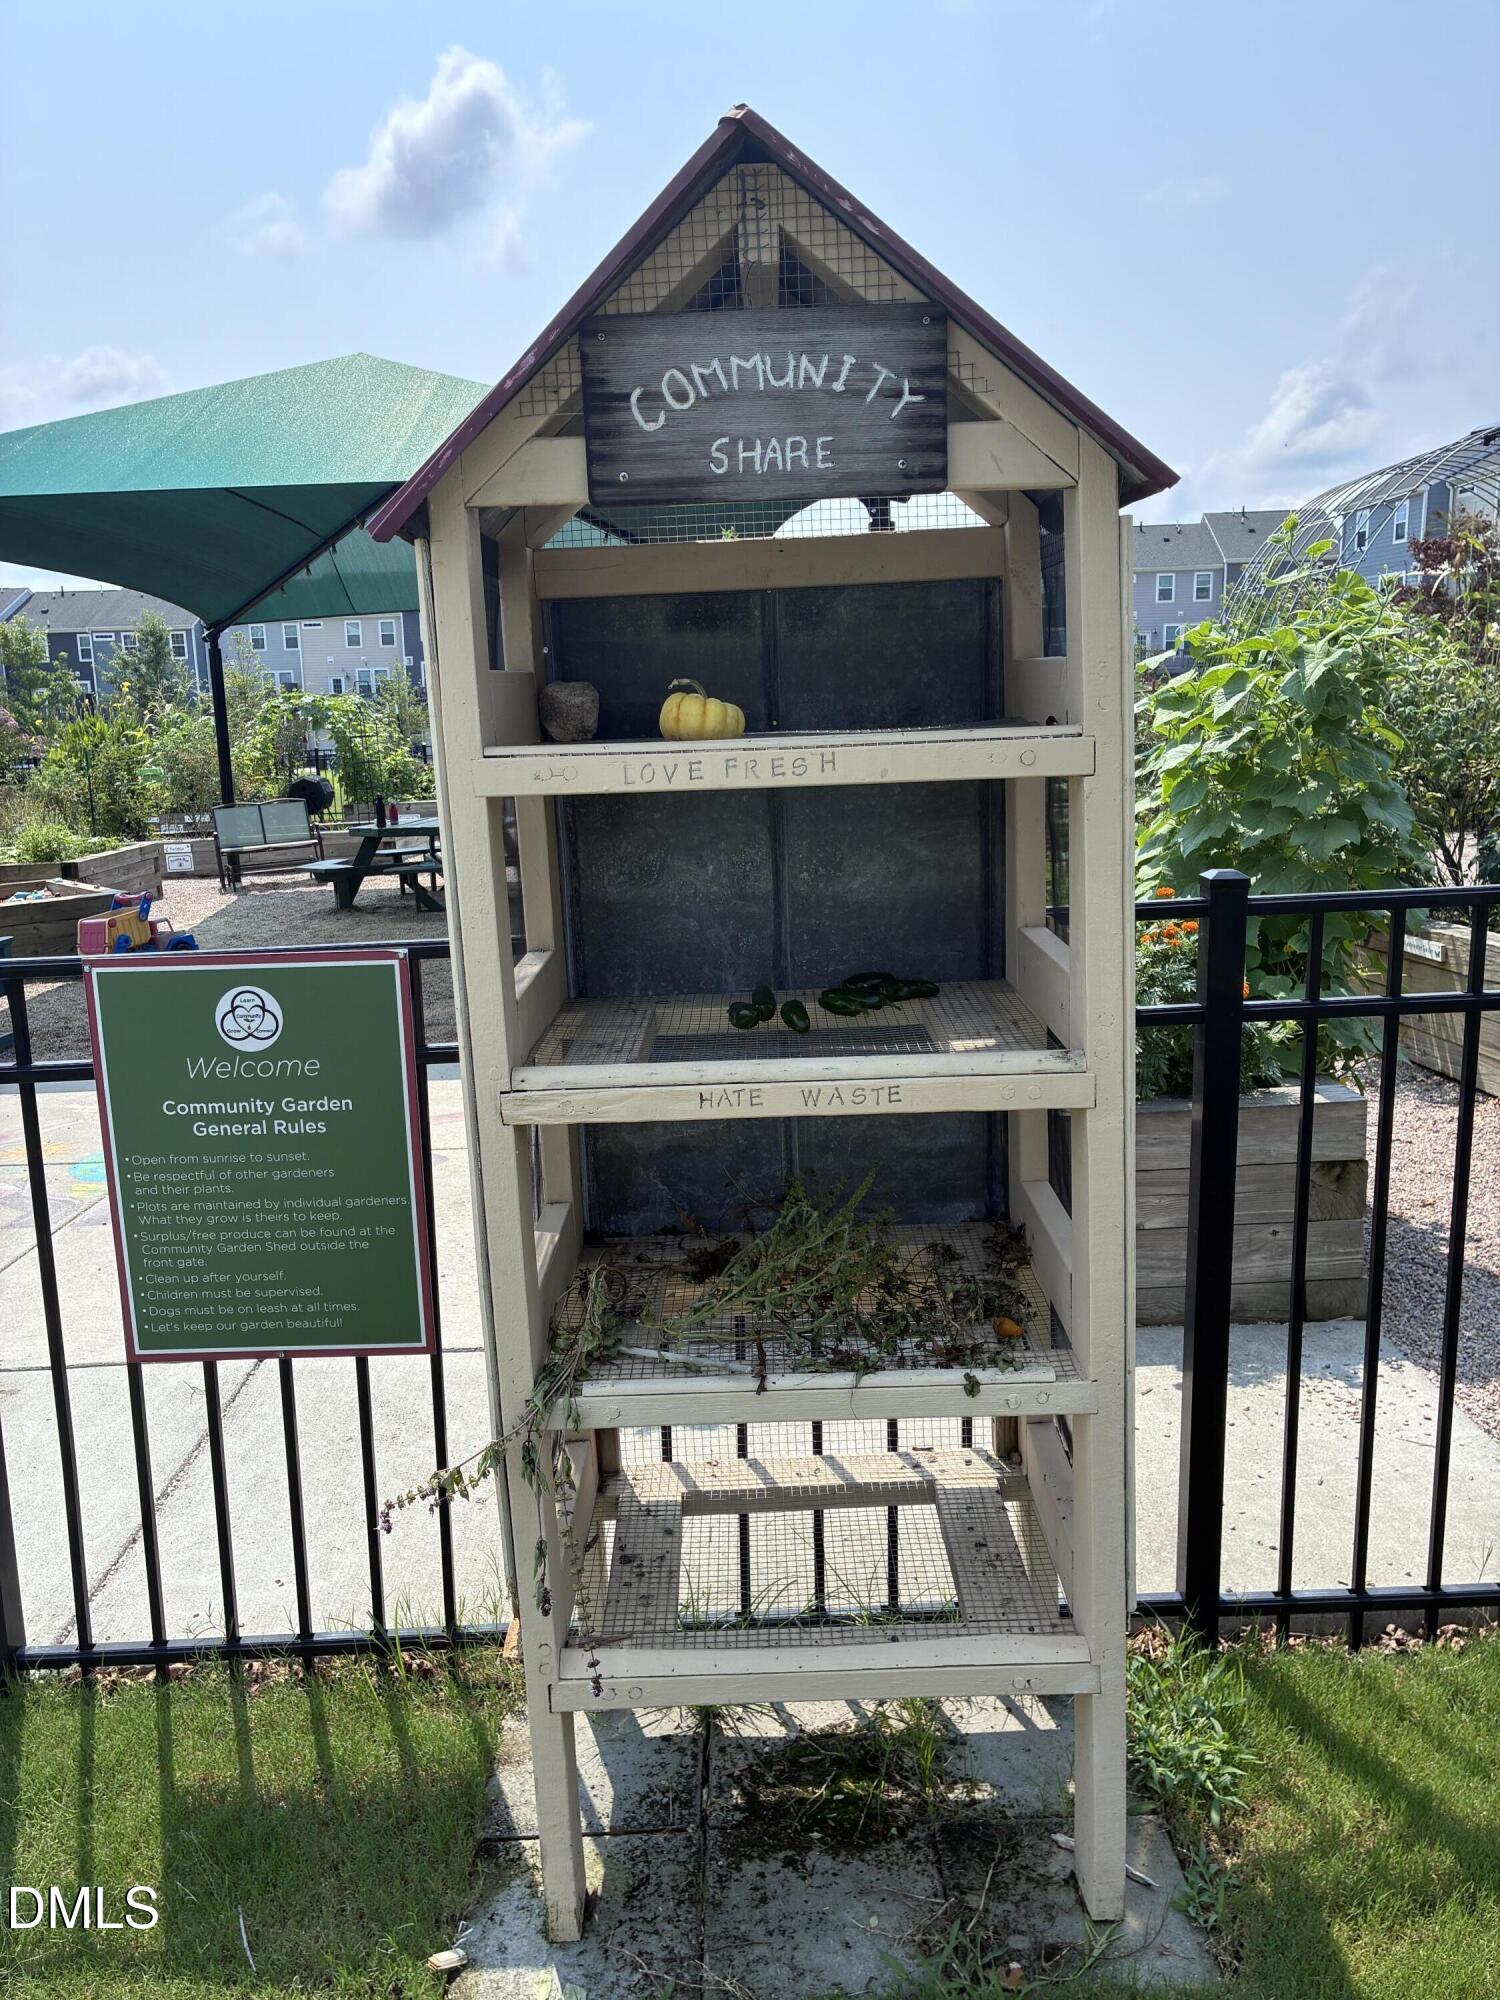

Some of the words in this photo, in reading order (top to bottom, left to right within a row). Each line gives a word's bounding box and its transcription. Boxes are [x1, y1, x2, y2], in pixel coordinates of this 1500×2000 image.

[630, 352, 926, 431] COMMUNITY
[709, 436, 837, 474] SHARE
[622, 760, 704, 785] LOVE
[724, 751, 838, 780] FRESH
[186, 1055, 320, 1079] Welcome
[699, 1089, 765, 1109] HATE
[800, 1085, 903, 1108] WASTE
[162, 1097, 275, 1116] Community
[281, 1096, 353, 1112] Garden
[192, 1121, 267, 1137] General
[274, 1119, 327, 1134] Rules
[132, 1155, 166, 1166] Open
[170, 1154, 199, 1164] from
[203, 1153, 246, 1163] sunrise
[250, 1153, 263, 1163] to
[266, 1152, 310, 1162] sunset.
[134, 1172, 150, 1181] Be
[154, 1170, 215, 1182] respectful
[219, 1170, 231, 1180] of
[235, 1170, 268, 1179] other
[272, 1168, 335, 1180] gardeners
[135, 1185, 158, 1195] and
[162, 1185, 189, 1194] their
[194, 1184, 234, 1195] plants.
[137, 1202, 167, 1211] Plots
[170, 1202, 190, 1211] are
[194, 1200, 261, 1209] maintained
[265, 1198, 279, 1210] by
[284, 1197, 341, 1208] individual
[345, 1196, 409, 1209] gardeners.
[138, 1215, 172, 1225] What
[175, 1214, 202, 1225] they
[207, 1215, 238, 1225] grow
[243, 1213, 251, 1222] is
[256, 1212, 289, 1222] theirs
[294, 1212, 306, 1221] to
[310, 1211, 343, 1222] keep.
[140, 1230, 216, 1242] Surplus/free
[220, 1229, 271, 1240] produce
[275, 1230, 296, 1238] can
[301, 1227, 316, 1237] be
[320, 1226, 356, 1237] found
[359, 1226, 371, 1236] at
[376, 1226, 395, 1235] the
[142, 1244, 213, 1255] Community
[217, 1242, 262, 1251] Garden
[265, 1241, 296, 1251] Shed
[300, 1240, 345, 1250] outside
[350, 1240, 369, 1249] the
[144, 1258, 173, 1268] front
[177, 1258, 207, 1268] gate.
[145, 1274, 179, 1284] Clean
[183, 1275, 199, 1284] up
[203, 1272, 231, 1282] after
[235, 1271, 286, 1284] yourself.
[148, 1290, 198, 1300] Children
[201, 1289, 231, 1298] must
[236, 1288, 251, 1297] be
[150, 1306, 180, 1317] Dogs
[184, 1305, 214, 1315] must
[218, 1305, 234, 1314] be
[238, 1305, 253, 1313] on
[257, 1302, 287, 1313] leash
[292, 1303, 302, 1312] at
[307, 1302, 320, 1312] all
[324, 1302, 360, 1312] times.
[151, 1322, 180, 1332] Let's
[183, 1321, 213, 1331] keep
[216, 1322, 236, 1330] our
[240, 1320, 283, 1331] garden
